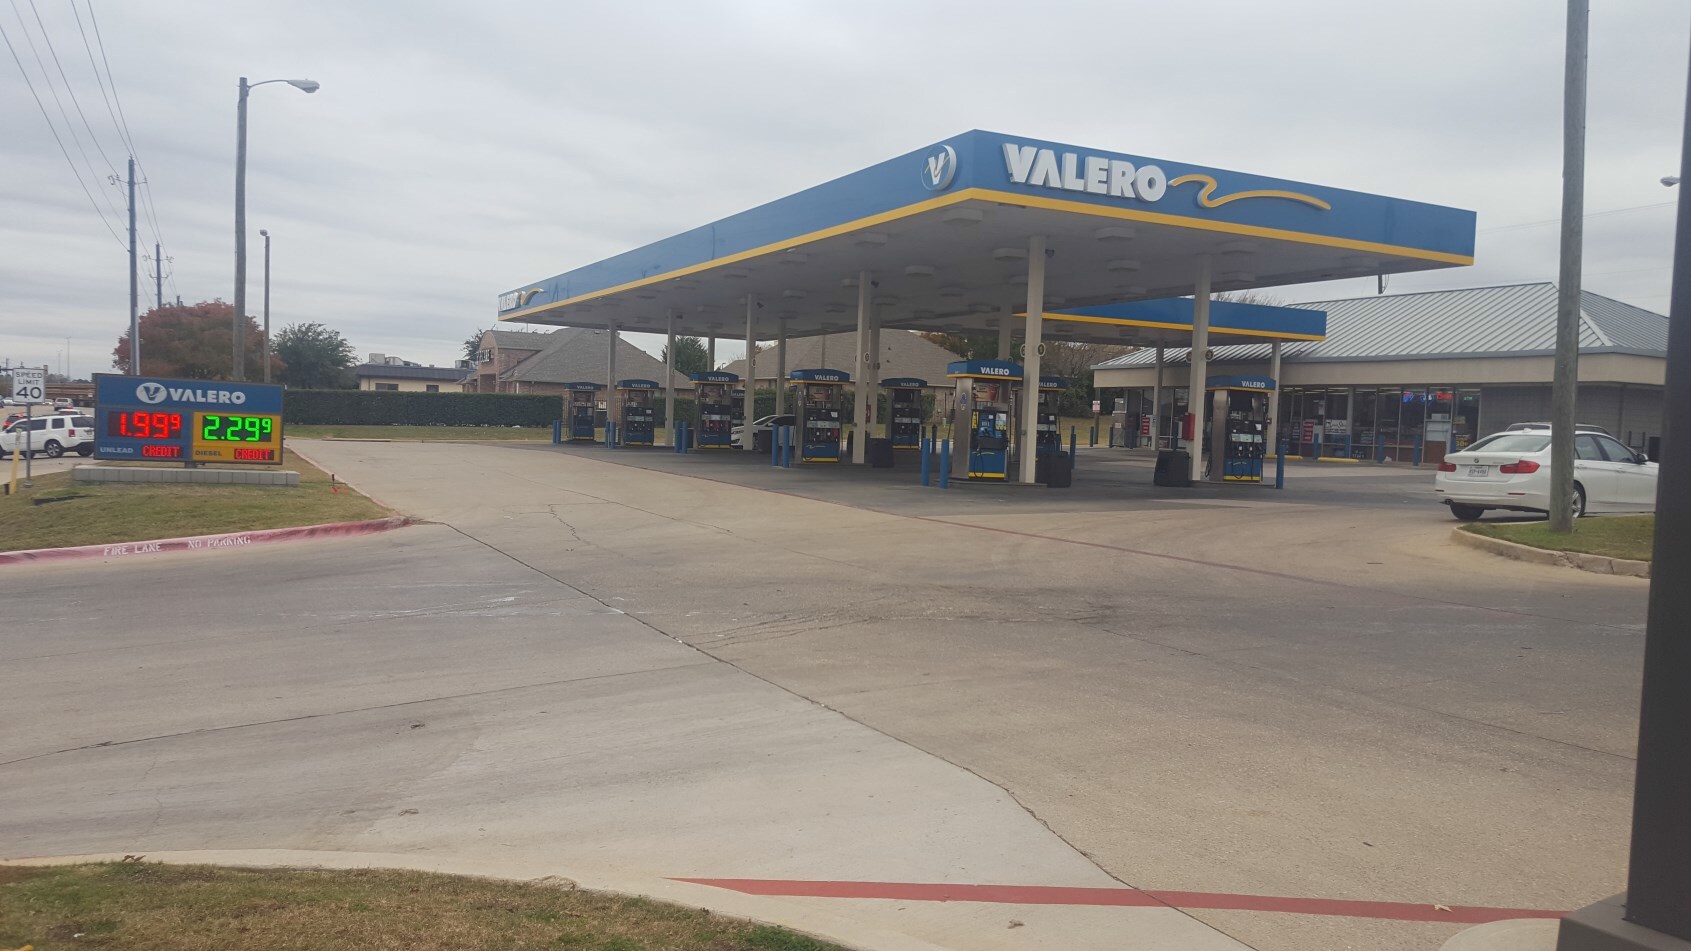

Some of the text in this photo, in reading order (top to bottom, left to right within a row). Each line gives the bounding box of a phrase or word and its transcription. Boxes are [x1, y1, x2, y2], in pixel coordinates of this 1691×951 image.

[1002, 143, 1167, 202] VALERO
[981, 367, 1009, 376] VALERO
[1241, 380, 1265, 388] VALERO
[16, 386, 42, 399] 40
[169, 388, 246, 404] VALERO
[142, 445, 179, 457] CREDIT
[235, 449, 270, 460] CREDIT
[188, 536, 251, 549] NO PARKING
[104, 543, 162, 556] FIRE LANE
